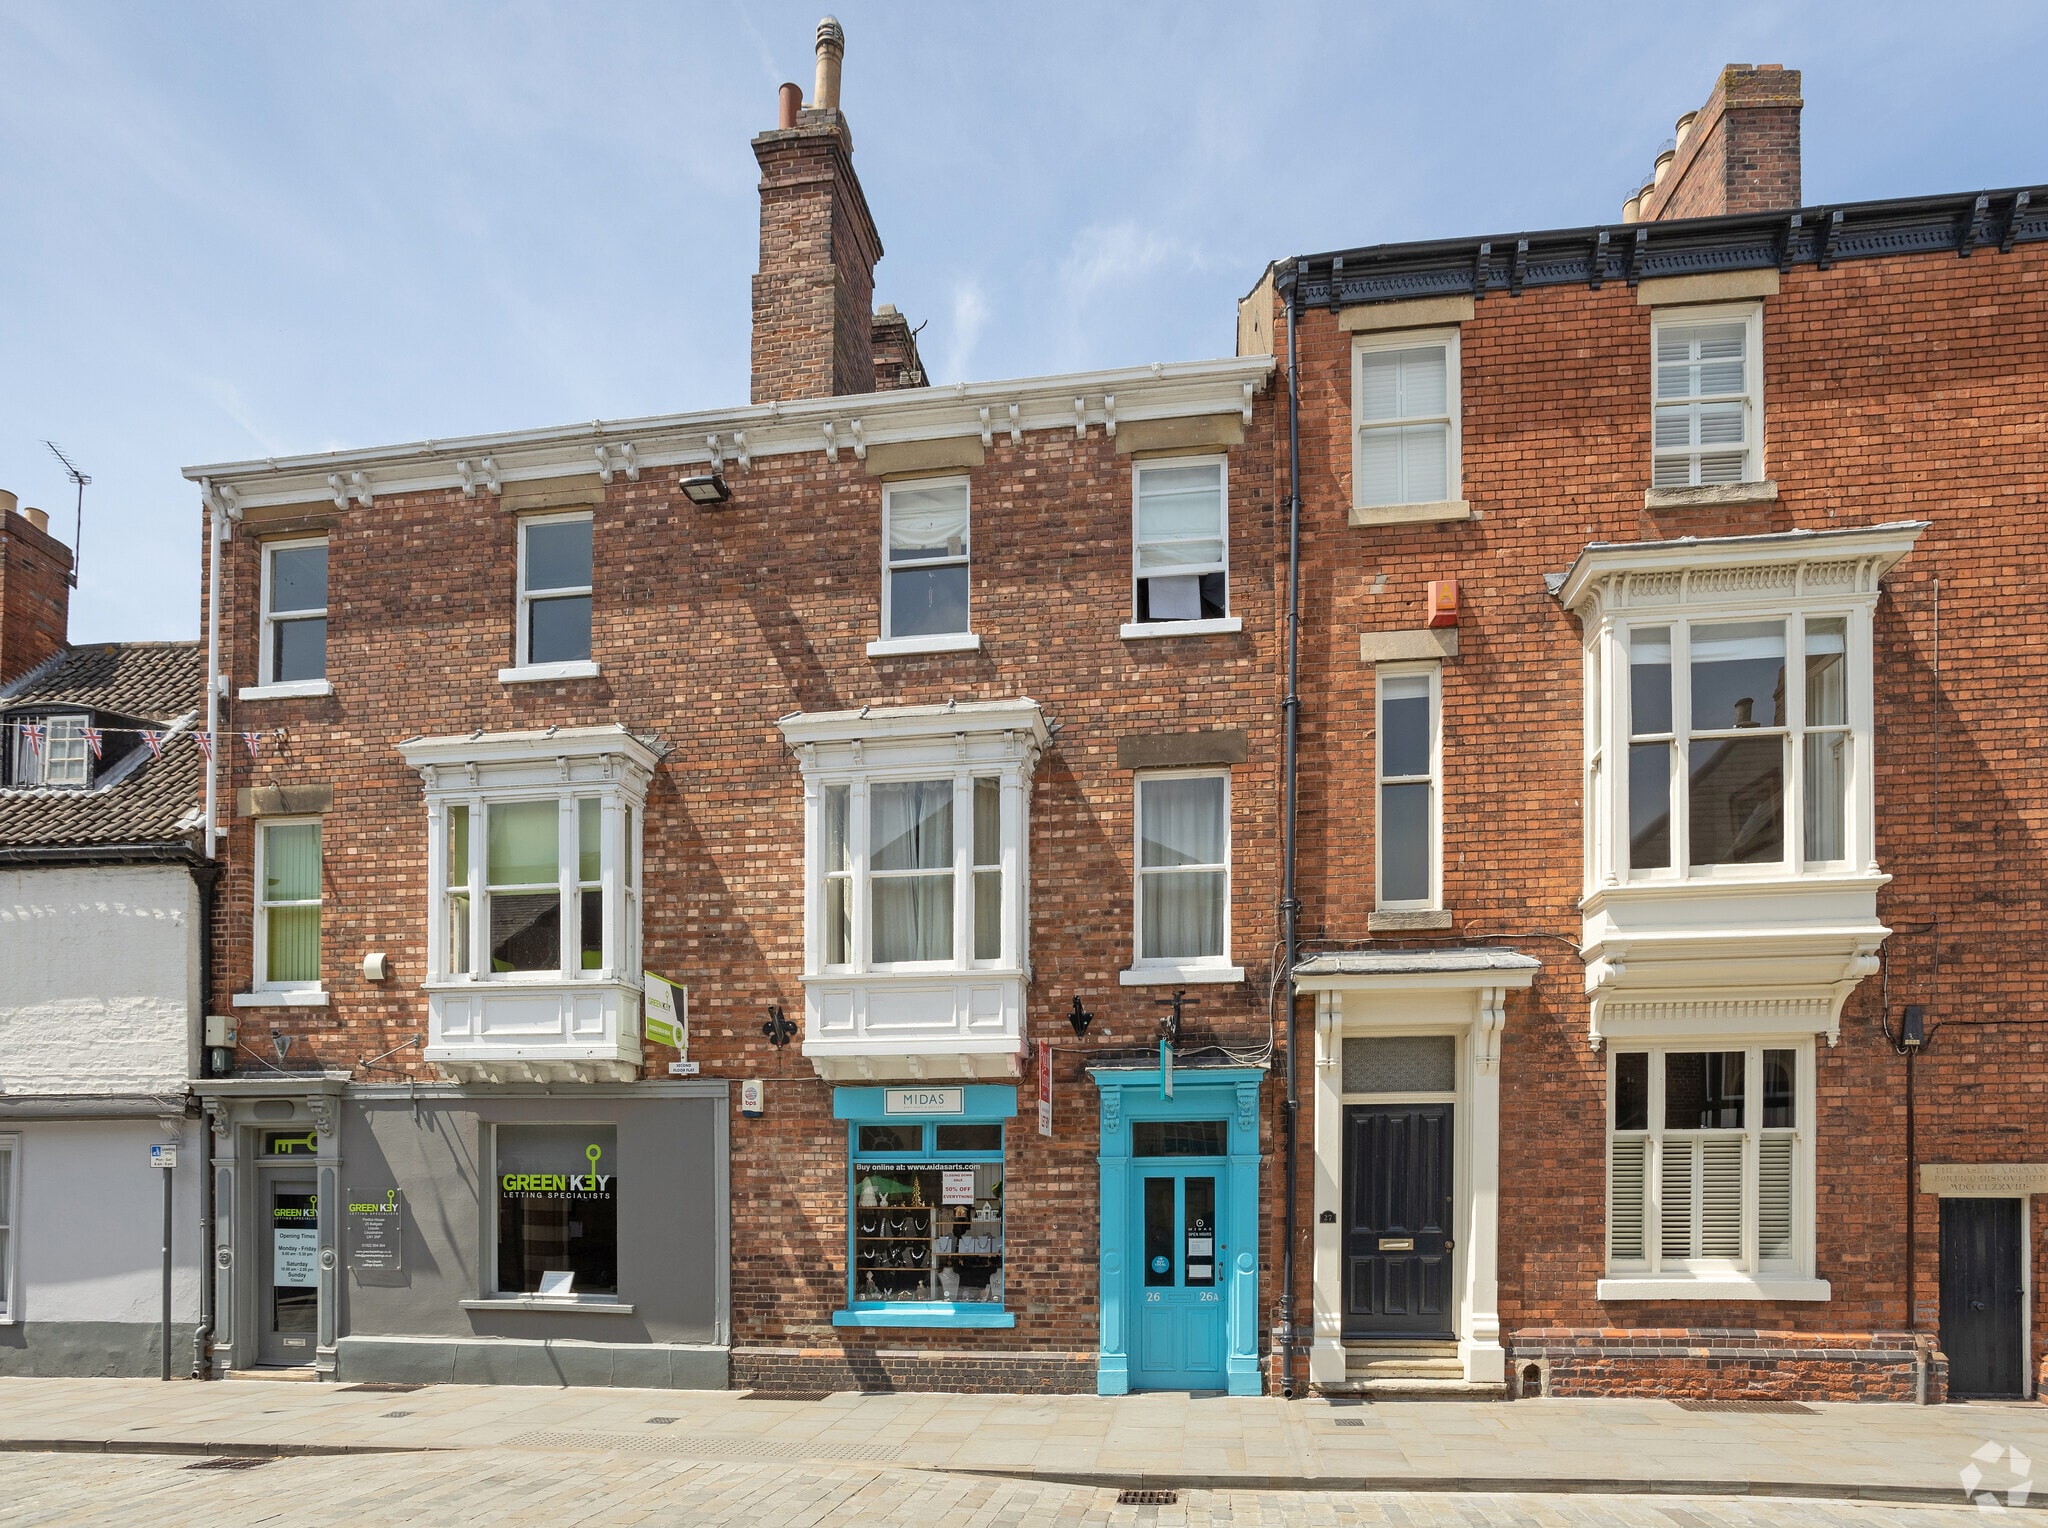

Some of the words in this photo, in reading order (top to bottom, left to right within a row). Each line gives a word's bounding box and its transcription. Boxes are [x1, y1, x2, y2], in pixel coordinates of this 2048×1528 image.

[648, 997, 662, 1008] GREEN
[904, 1094, 944, 1104] MIDAS
[503, 1174, 566, 1191] GREEN
[274, 1208, 302, 1217] GREEN
[349, 1204, 378, 1212] GREEN
[1146, 1292, 1160, 1301] 26
[1200, 1292, 1219, 1301] 26A
